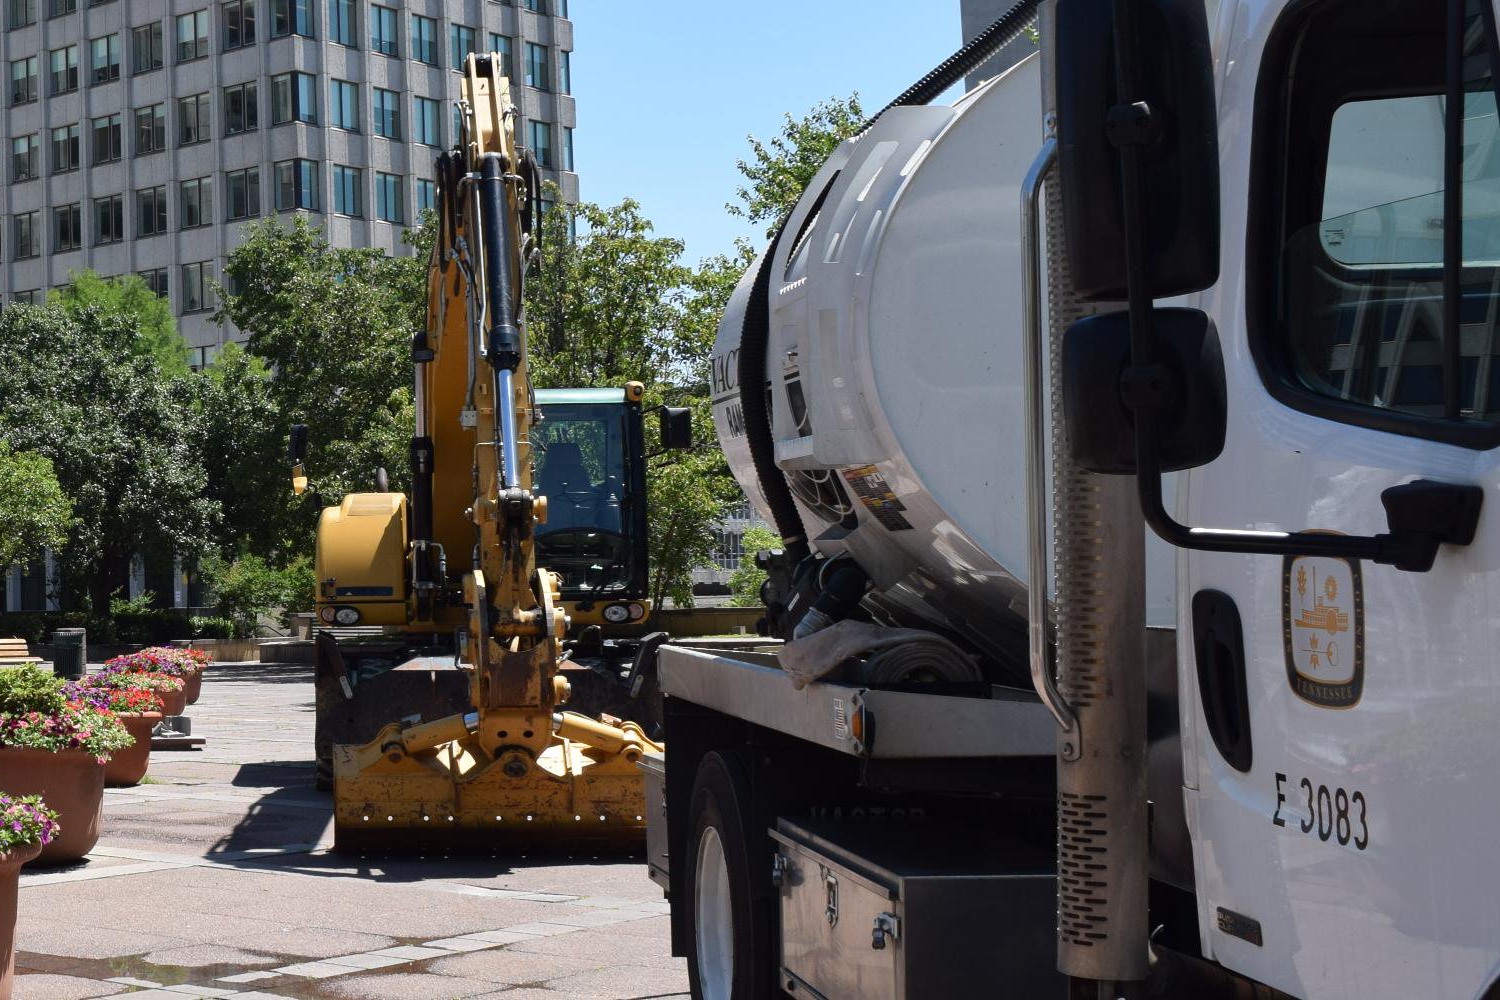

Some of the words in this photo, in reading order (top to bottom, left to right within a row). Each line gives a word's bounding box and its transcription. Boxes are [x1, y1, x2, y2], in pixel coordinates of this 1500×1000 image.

[1296, 678, 1353, 700] TENNESSEE
[1272, 772, 1287, 827] E
[1300, 777, 1369, 851] 3083
